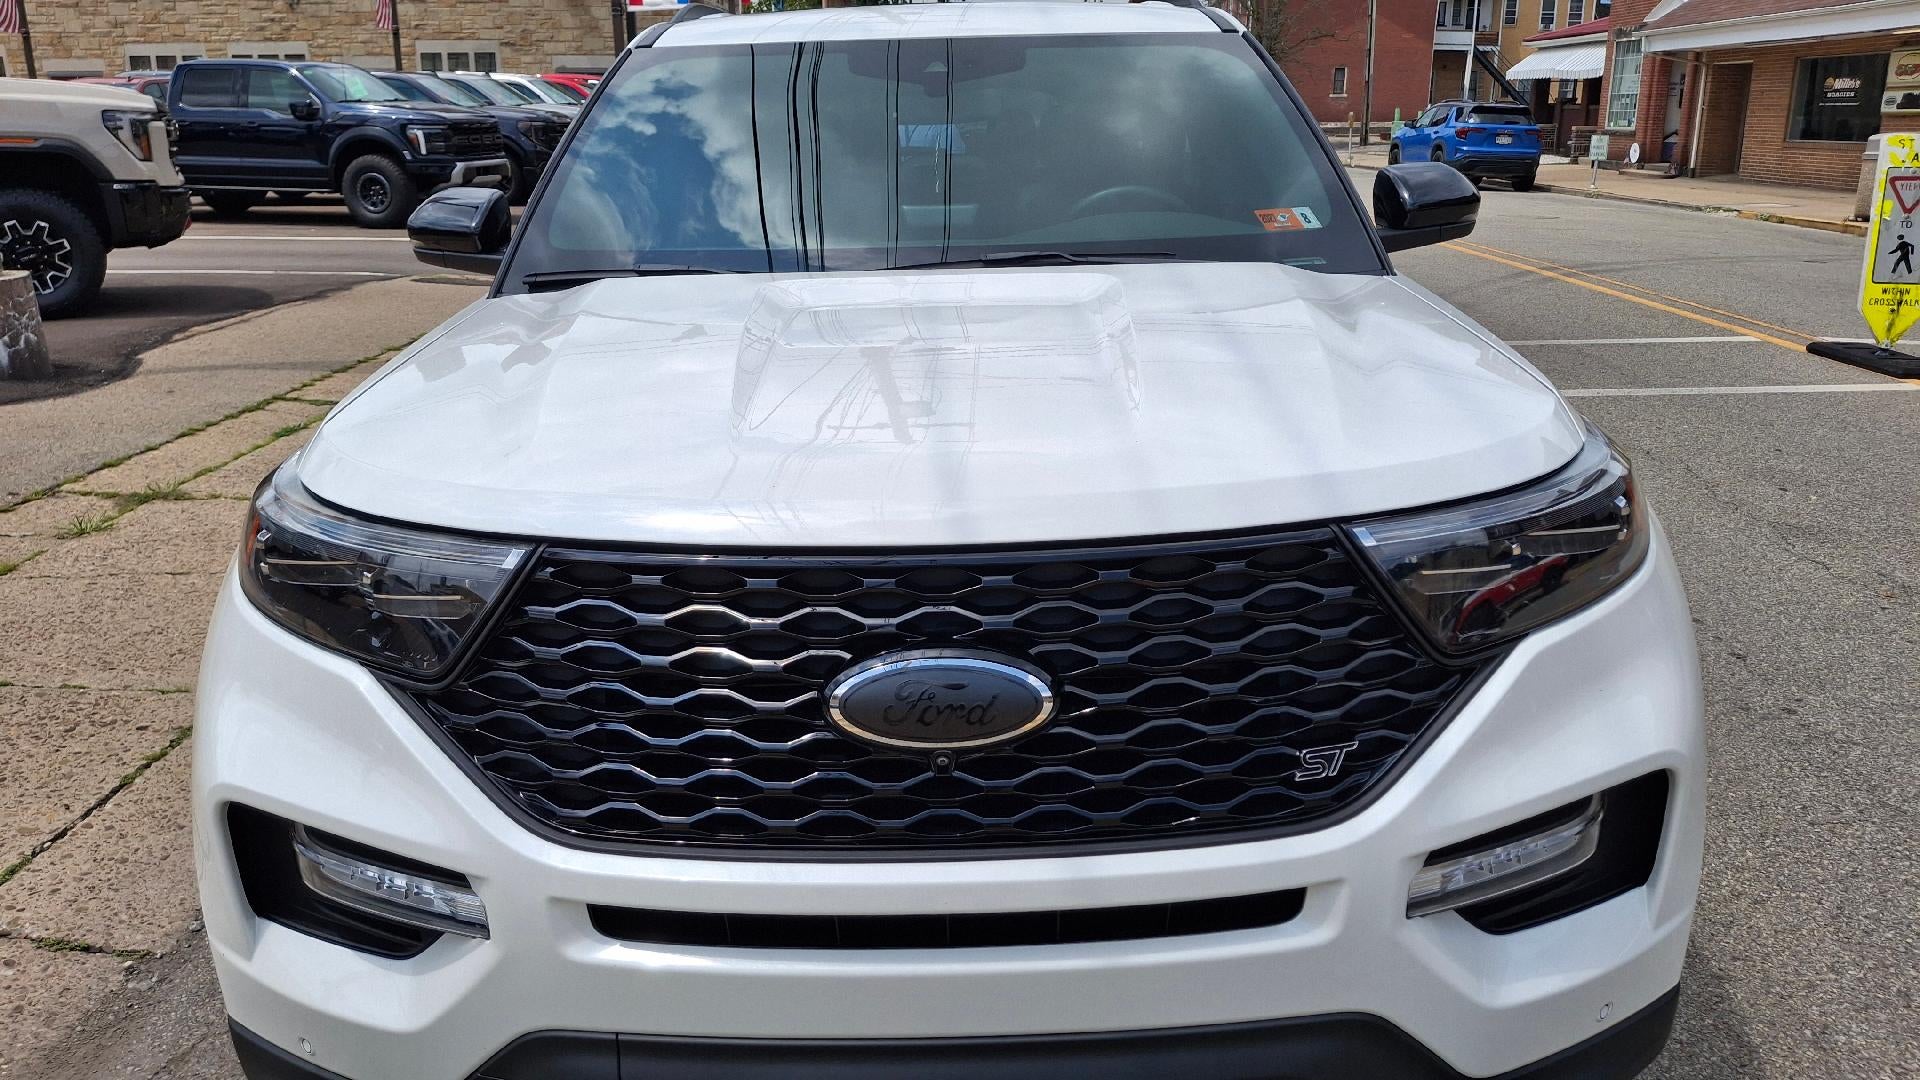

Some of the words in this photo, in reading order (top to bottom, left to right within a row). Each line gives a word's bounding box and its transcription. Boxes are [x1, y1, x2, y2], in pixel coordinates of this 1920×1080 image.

[1300, 212, 1312, 224] 8
[1900, 220, 1913, 229] TO
[883, 679, 999, 727] Ford
[1295, 741, 1359, 781] ST
